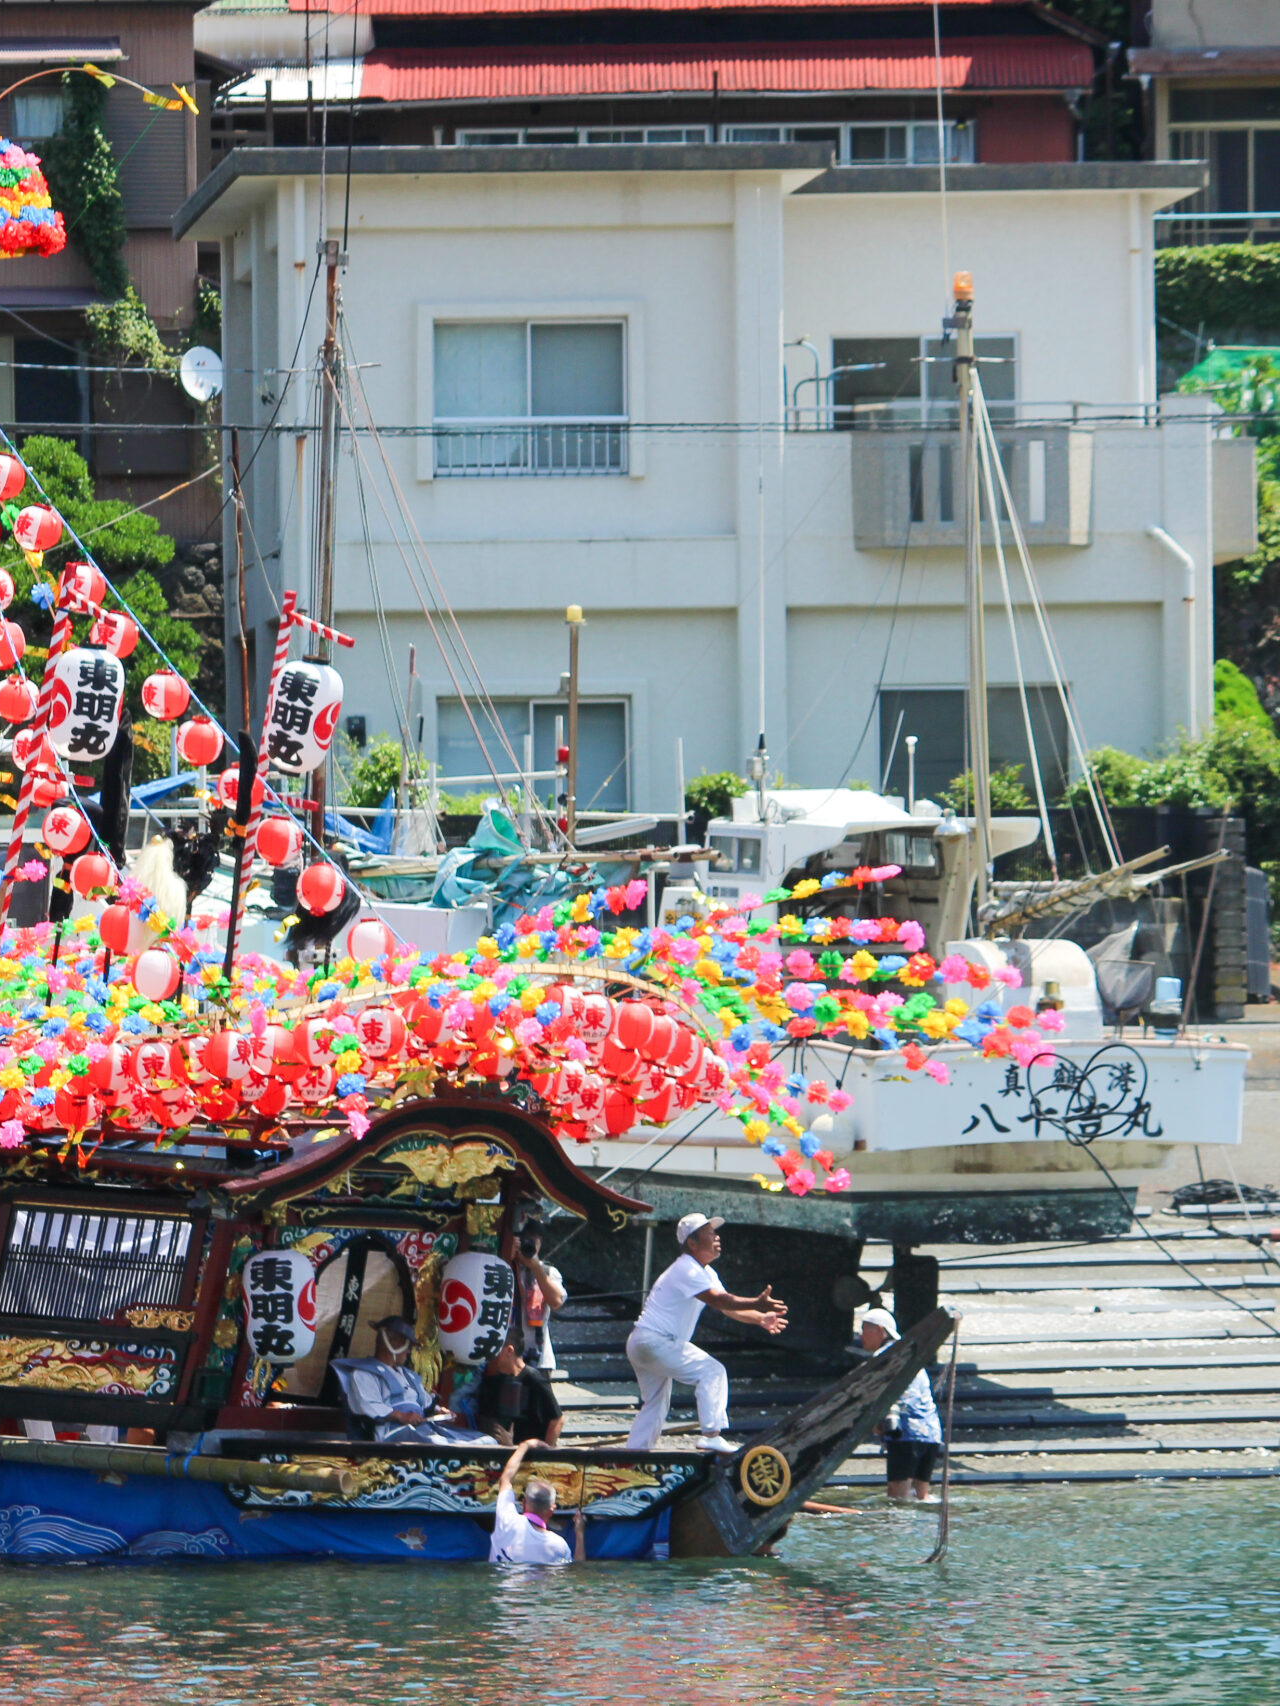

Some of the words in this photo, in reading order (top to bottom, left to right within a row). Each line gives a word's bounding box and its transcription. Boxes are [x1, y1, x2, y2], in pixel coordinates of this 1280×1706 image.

[15, 512, 34, 537] 東
[68, 659, 118, 755] 東明丸
[144, 683, 160, 707] 東
[268, 670, 319, 767] 東明丸
[48, 812, 73, 837] 東
[582, 1003, 607, 1030] 東
[361, 1018, 386, 1045] 東
[142, 1054, 167, 1079] 東
[565, 1069, 584, 1095] 東
[578, 1086, 600, 1111] 東
[962, 1095, 1163, 1138] 八十吉丸
[250, 1257, 295, 1356] 東明丸
[469, 1264, 514, 1361] 東明丸
